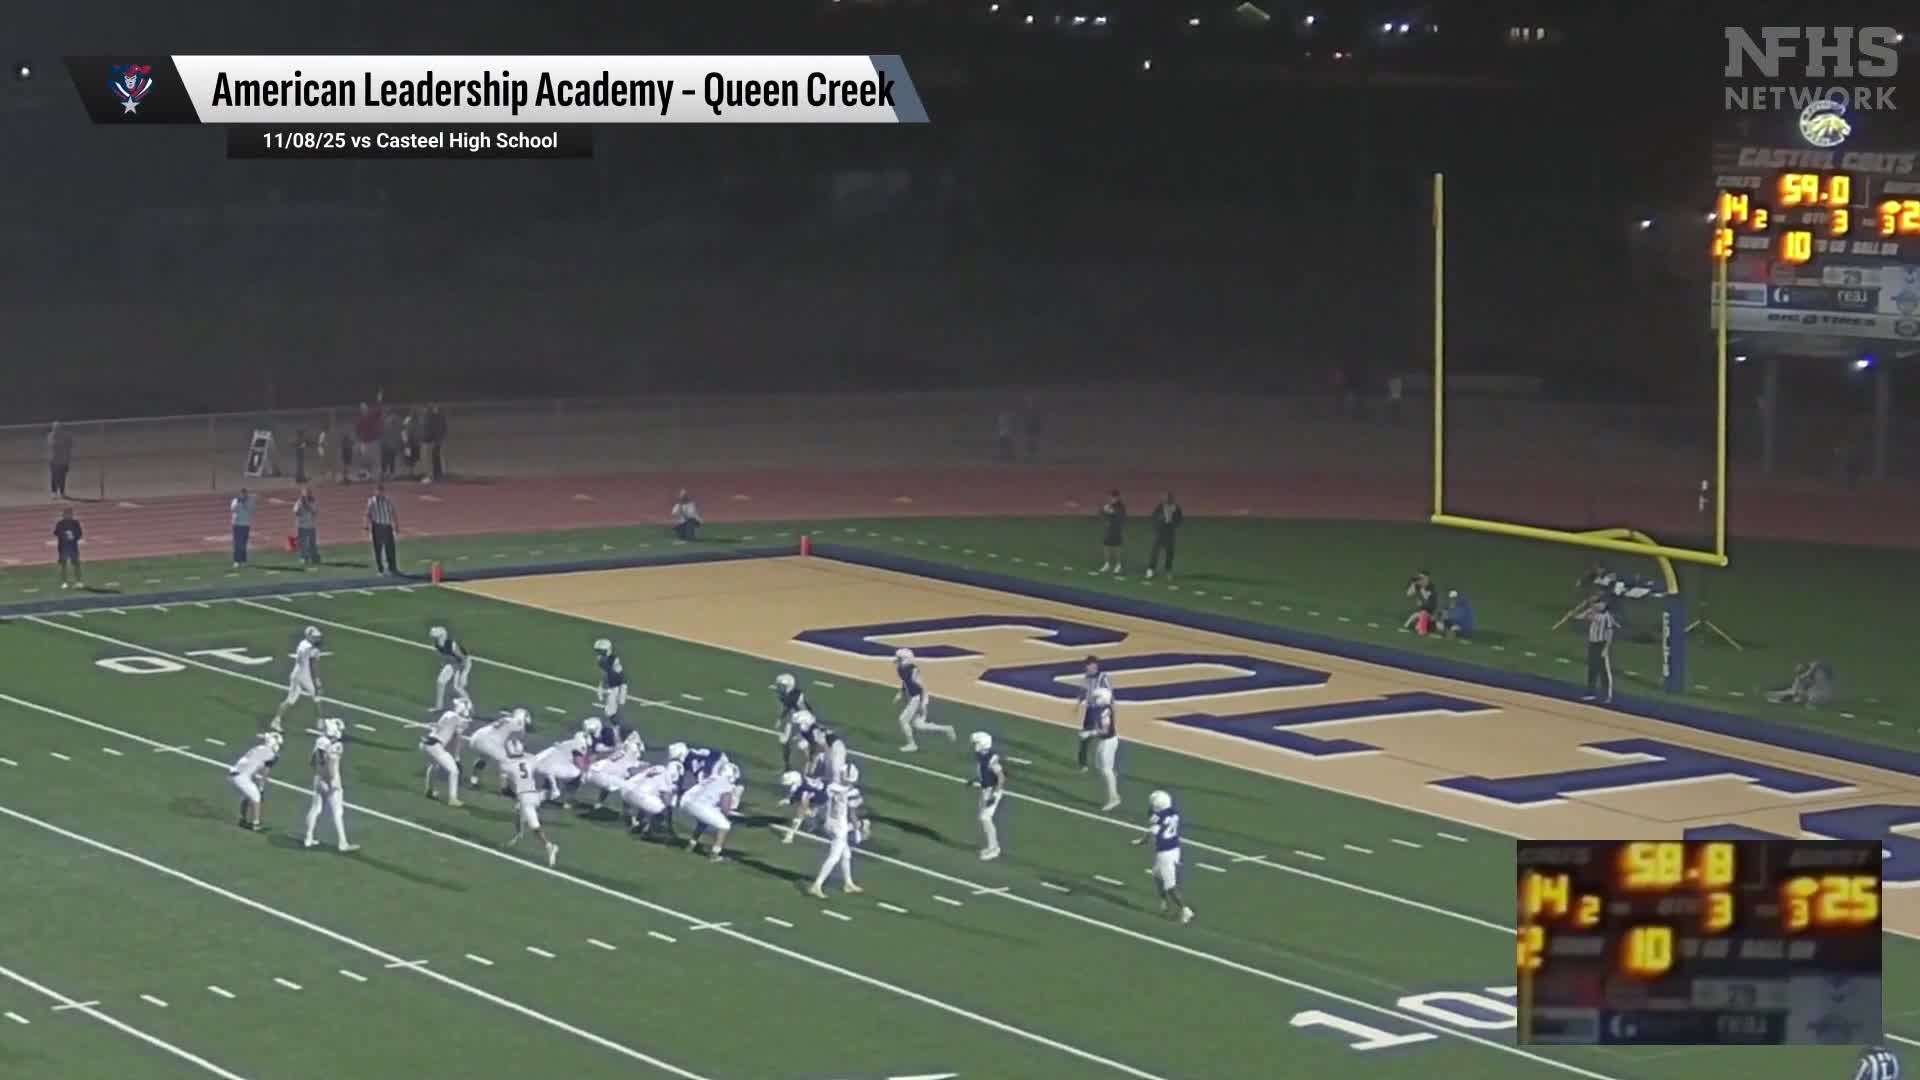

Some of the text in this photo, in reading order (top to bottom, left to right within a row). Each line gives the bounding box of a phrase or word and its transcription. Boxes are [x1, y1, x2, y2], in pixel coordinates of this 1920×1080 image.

[1780, 173, 1851, 207] 59.0
[1719, 192, 1748, 223] 14
[1753, 209, 1768, 229] 2
[1831, 209, 1849, 235] 3
[1881, 214, 1896, 235] 3
[1782, 231, 1812, 262] 10
[518, 763, 529, 779] 5
[1622, 842, 1735, 889] 58.8
[1526, 873, 1570, 915] 14
[1819, 877, 1880, 922] 25
[1578, 895, 1601, 925] 2
[1706, 893, 1733, 931] 3
[1786, 898, 1809, 929] 3
[1625, 927, 1674, 974] 10
